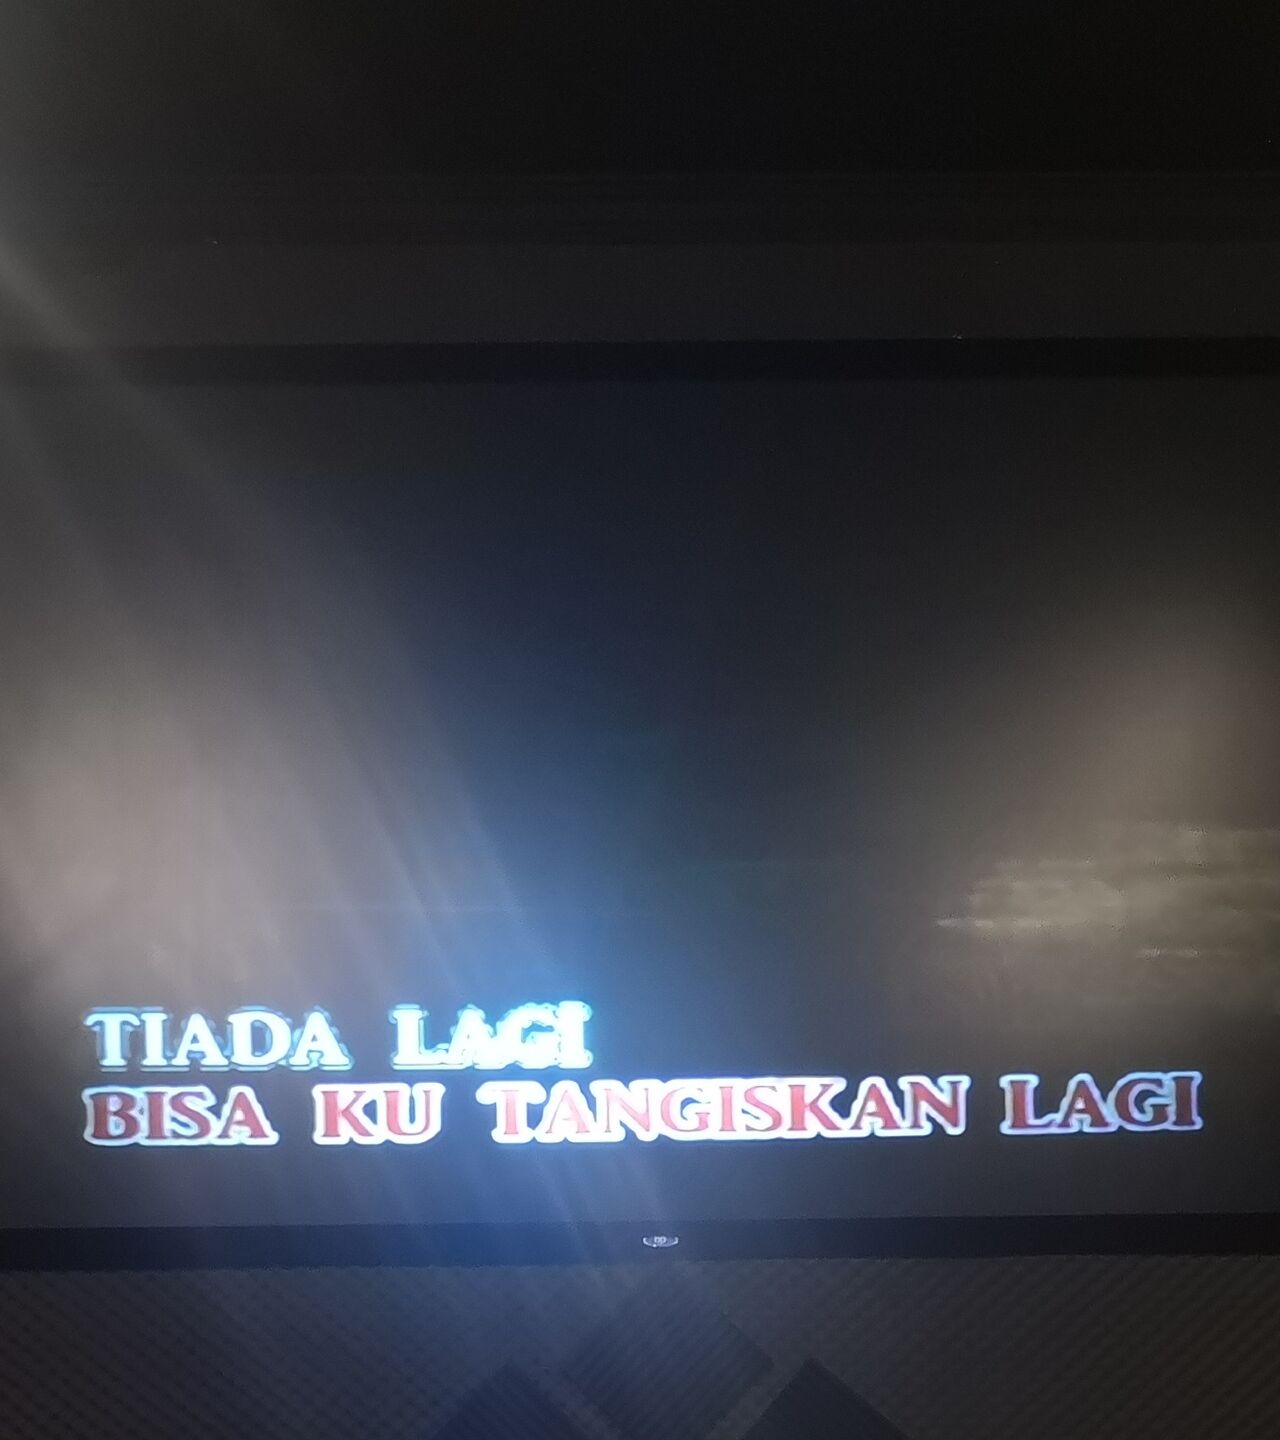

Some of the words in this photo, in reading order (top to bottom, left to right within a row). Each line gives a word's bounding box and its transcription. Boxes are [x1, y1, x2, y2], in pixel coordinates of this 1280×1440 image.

[83, 1006, 355, 1072] TIADA
[388, 1001, 594, 1071] LAGI
[82, 1085, 280, 1146] BISA
[312, 1082, 446, 1145] KU
[475, 1076, 972, 1144] TANGISKAN
[999, 1071, 1204, 1134] LAGI
